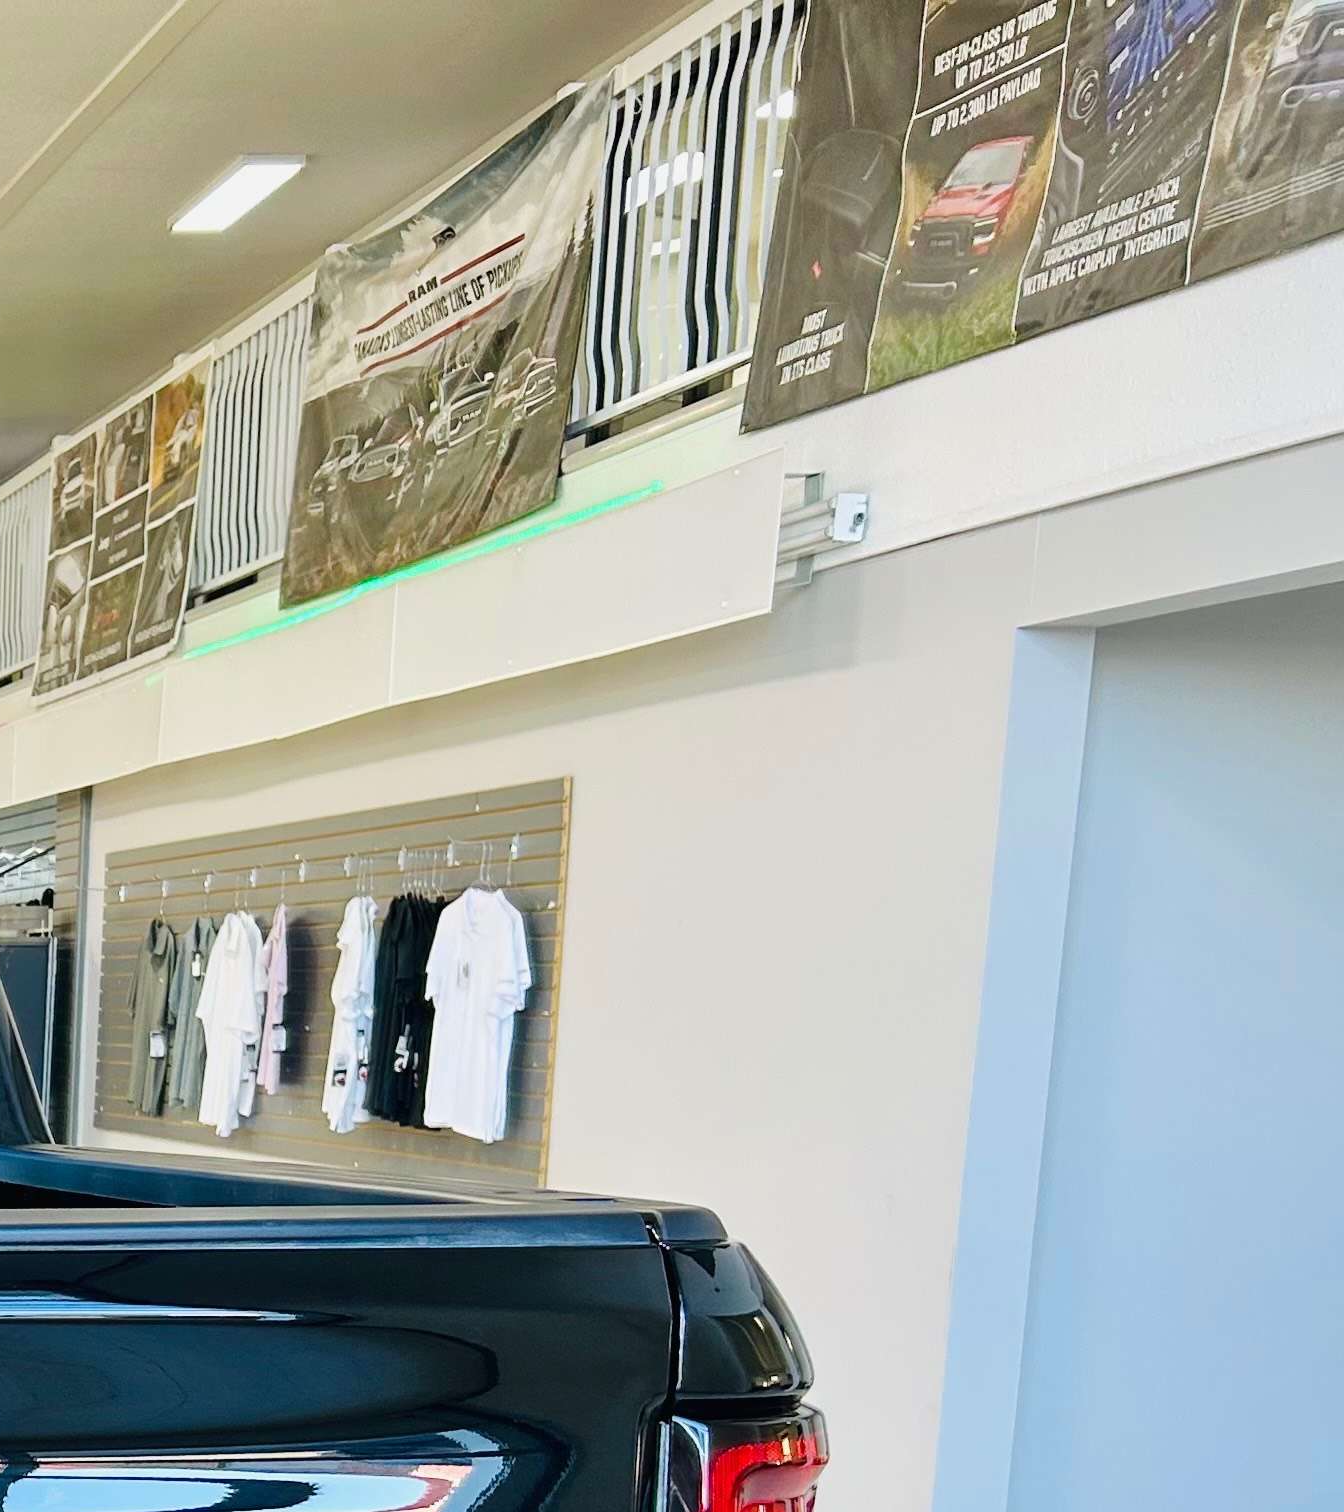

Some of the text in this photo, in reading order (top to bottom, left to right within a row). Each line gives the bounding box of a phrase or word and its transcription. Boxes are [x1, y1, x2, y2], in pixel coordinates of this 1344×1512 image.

[934, 26, 1002, 77] BEST-IN-CLASS
[1016, 0, 1057, 36] TOWING
[955, 35, 1030, 89] UP TO 12,750 LB
[930, 67, 1041, 137] UP TO 2,300 LB PAYLOAD
[1137, 200, 1180, 232] CENTRE
[1023, 270, 1050, 297] WITH
[1048, 260, 1078, 288] APPLE
[1122, 218, 1191, 261] INTEGRATION
[408, 276, 438, 304] RAM
[448, 283, 472, 313] LINE
[471, 275, 486, 301] OF
